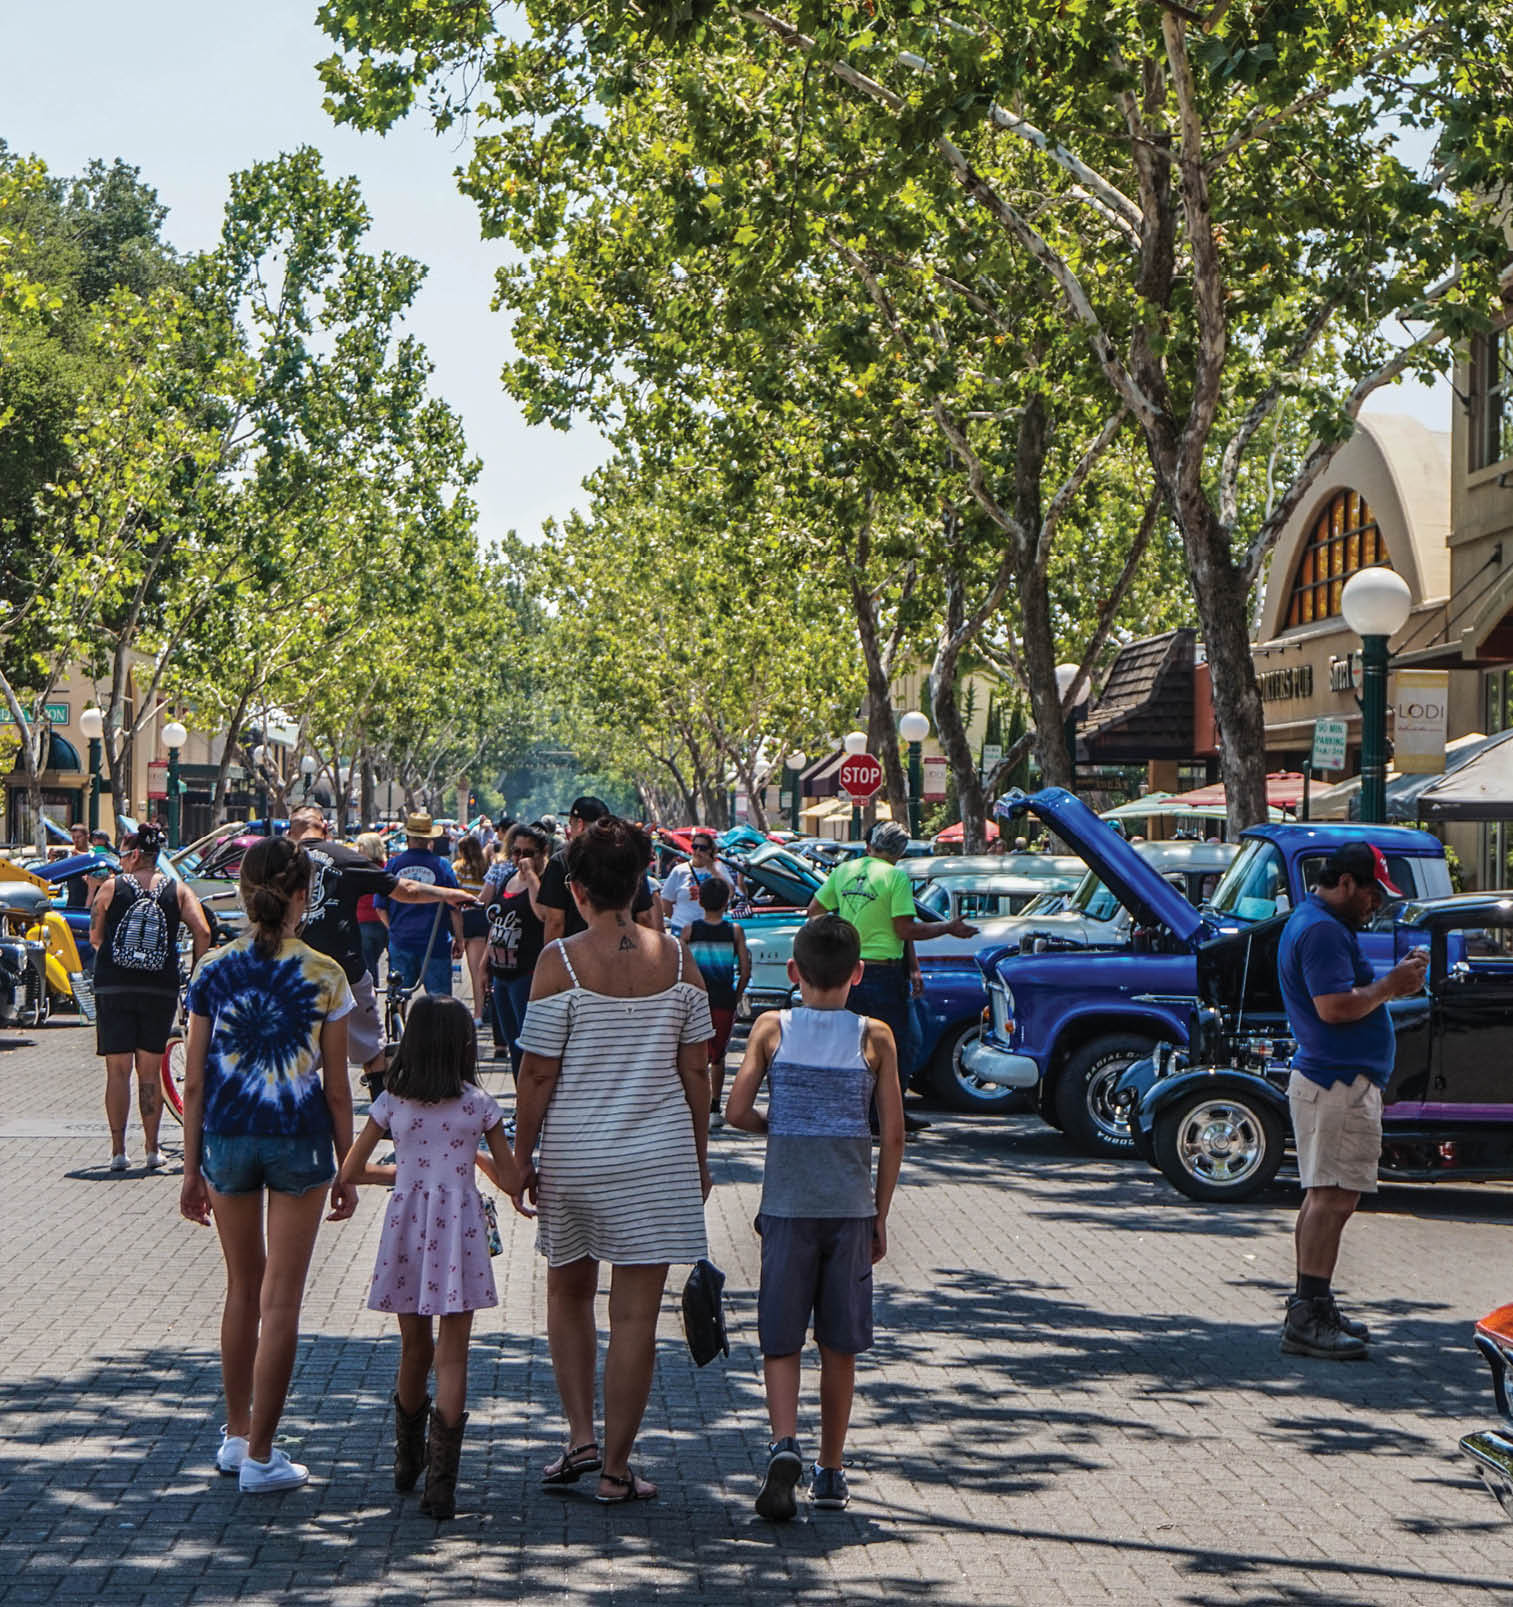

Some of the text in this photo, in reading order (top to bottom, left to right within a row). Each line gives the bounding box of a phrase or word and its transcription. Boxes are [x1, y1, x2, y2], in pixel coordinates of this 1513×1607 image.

[1399, 703, 1444, 719] LODI
[1316, 735, 1345, 746] PARKING
[842, 766, 880, 784] STOP
